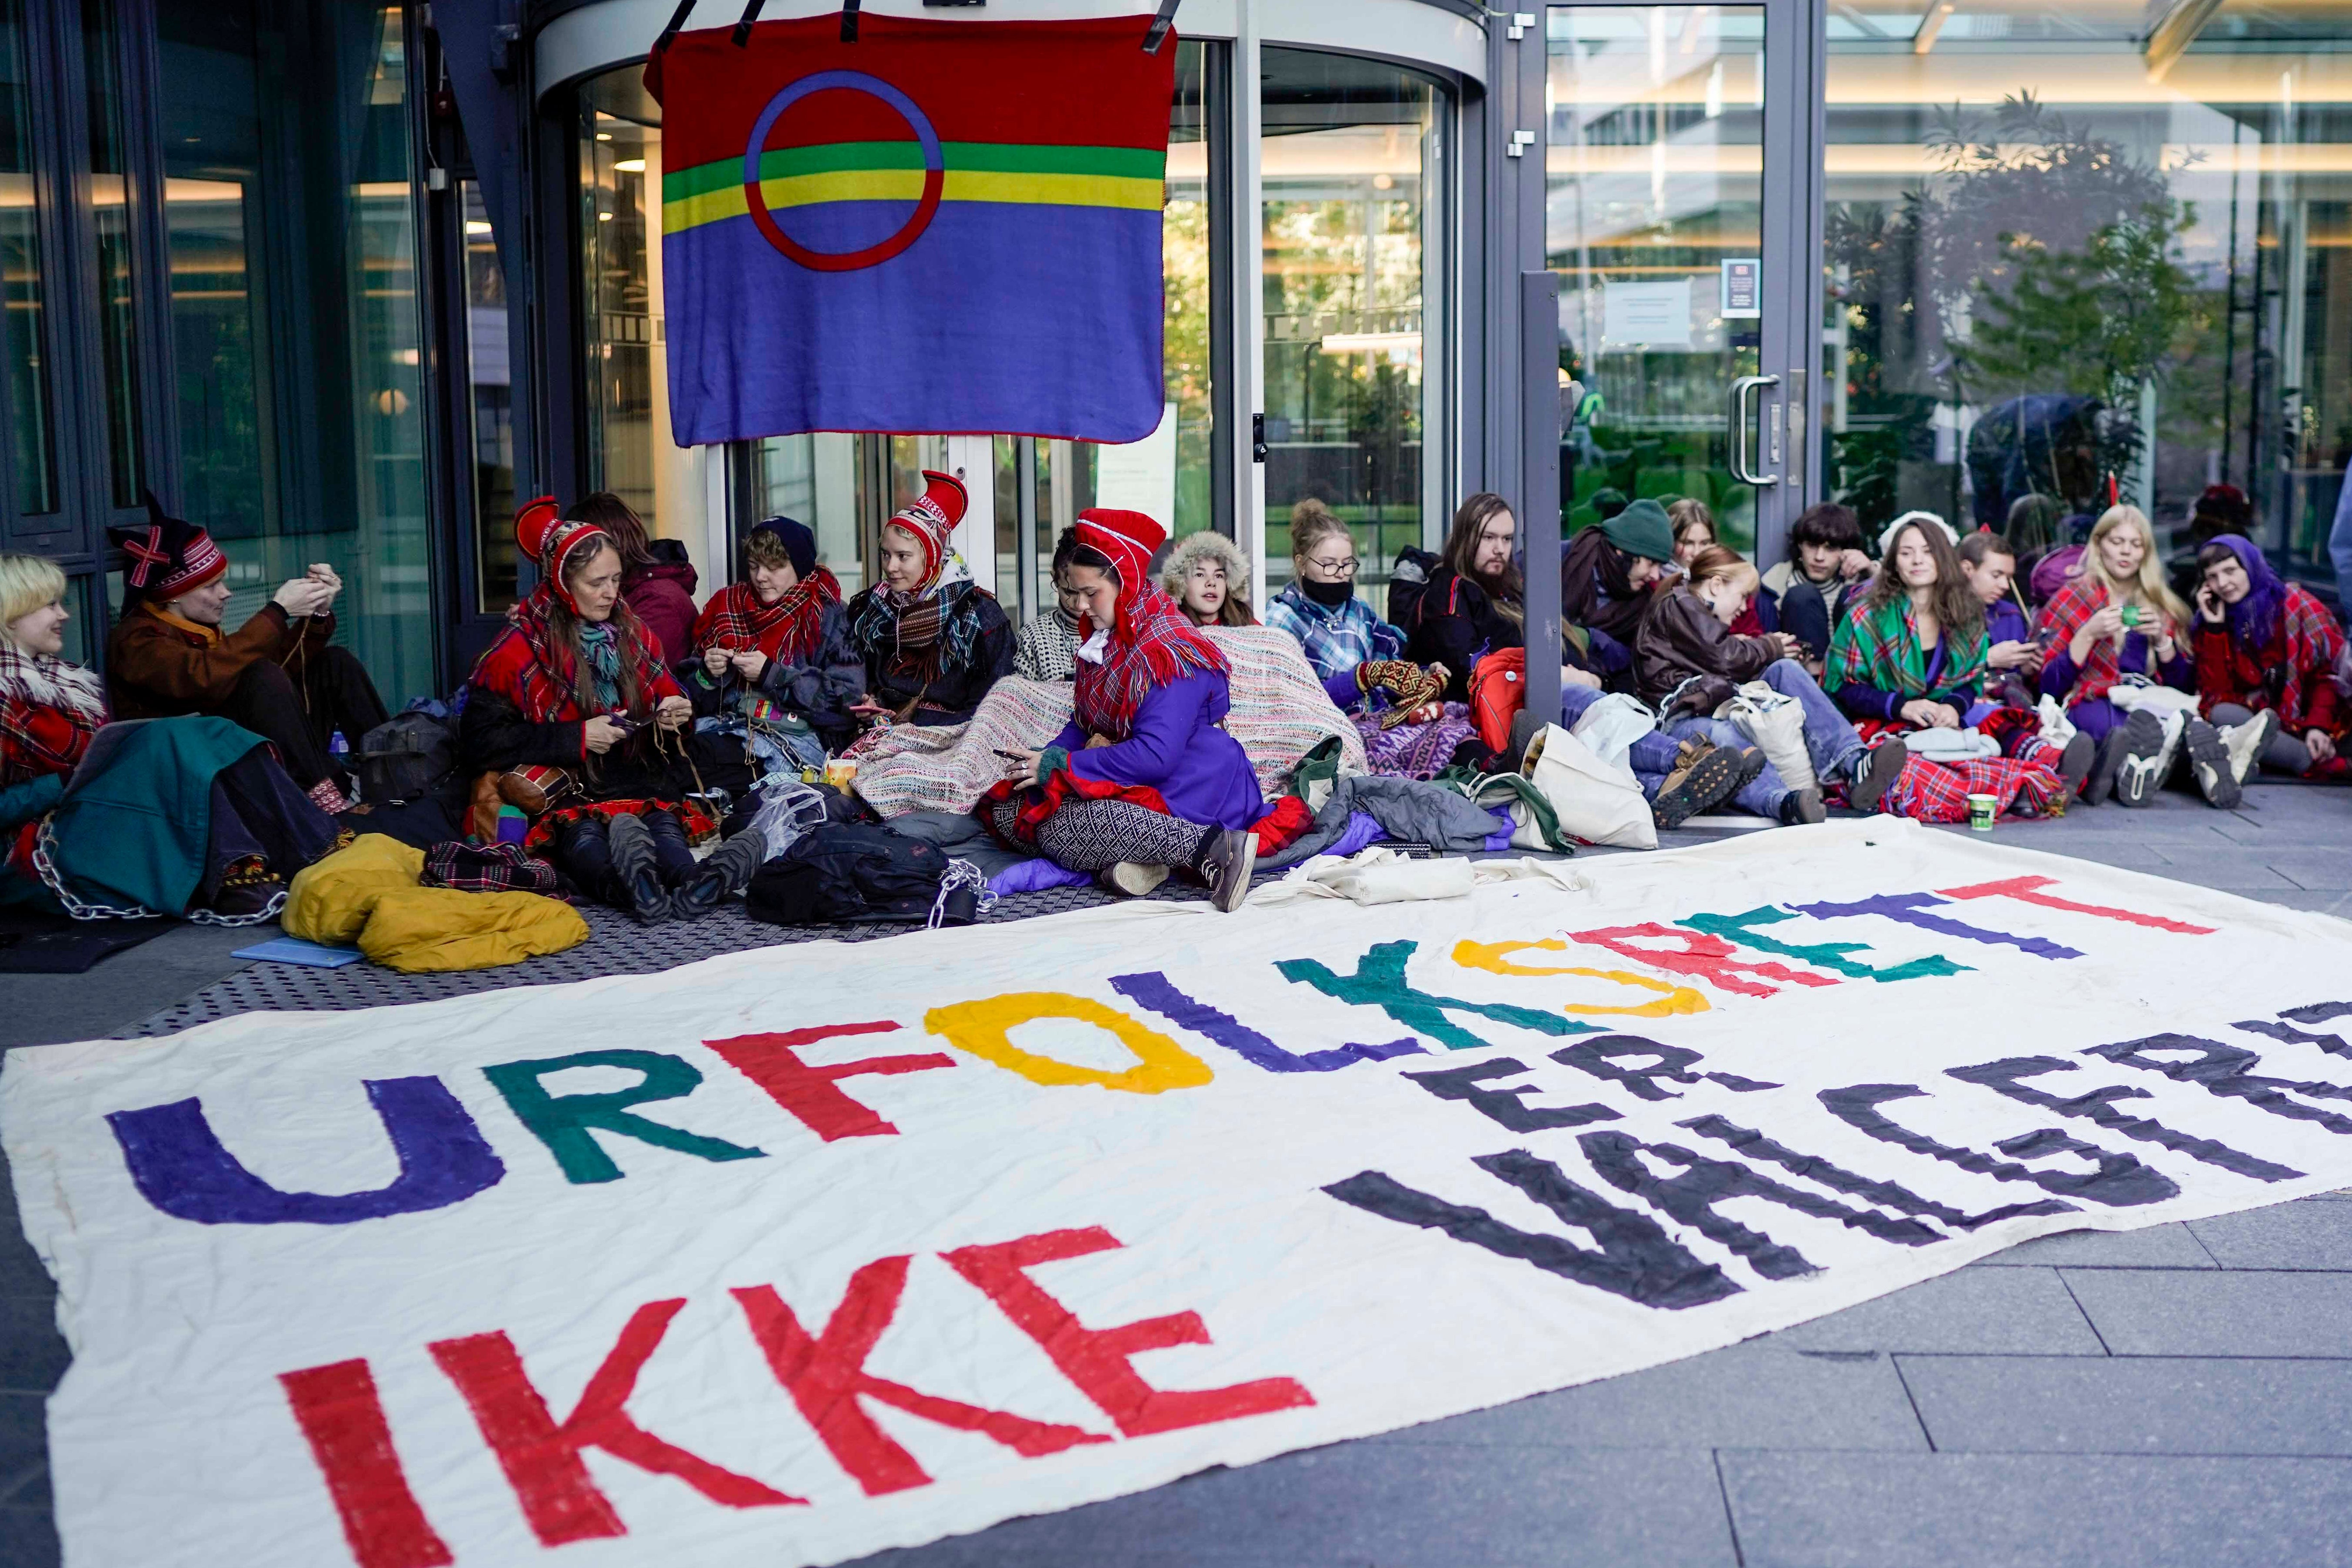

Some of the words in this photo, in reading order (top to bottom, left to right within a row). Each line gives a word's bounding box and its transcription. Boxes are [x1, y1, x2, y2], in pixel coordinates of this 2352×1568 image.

[103, 875, 2218, 1225] URFOLKSRETT
[1399, 1034, 1784, 1133] ER
[278, 1226, 1317, 1568] IKKE
[1320, 1001, 2352, 1309] VALGFR
